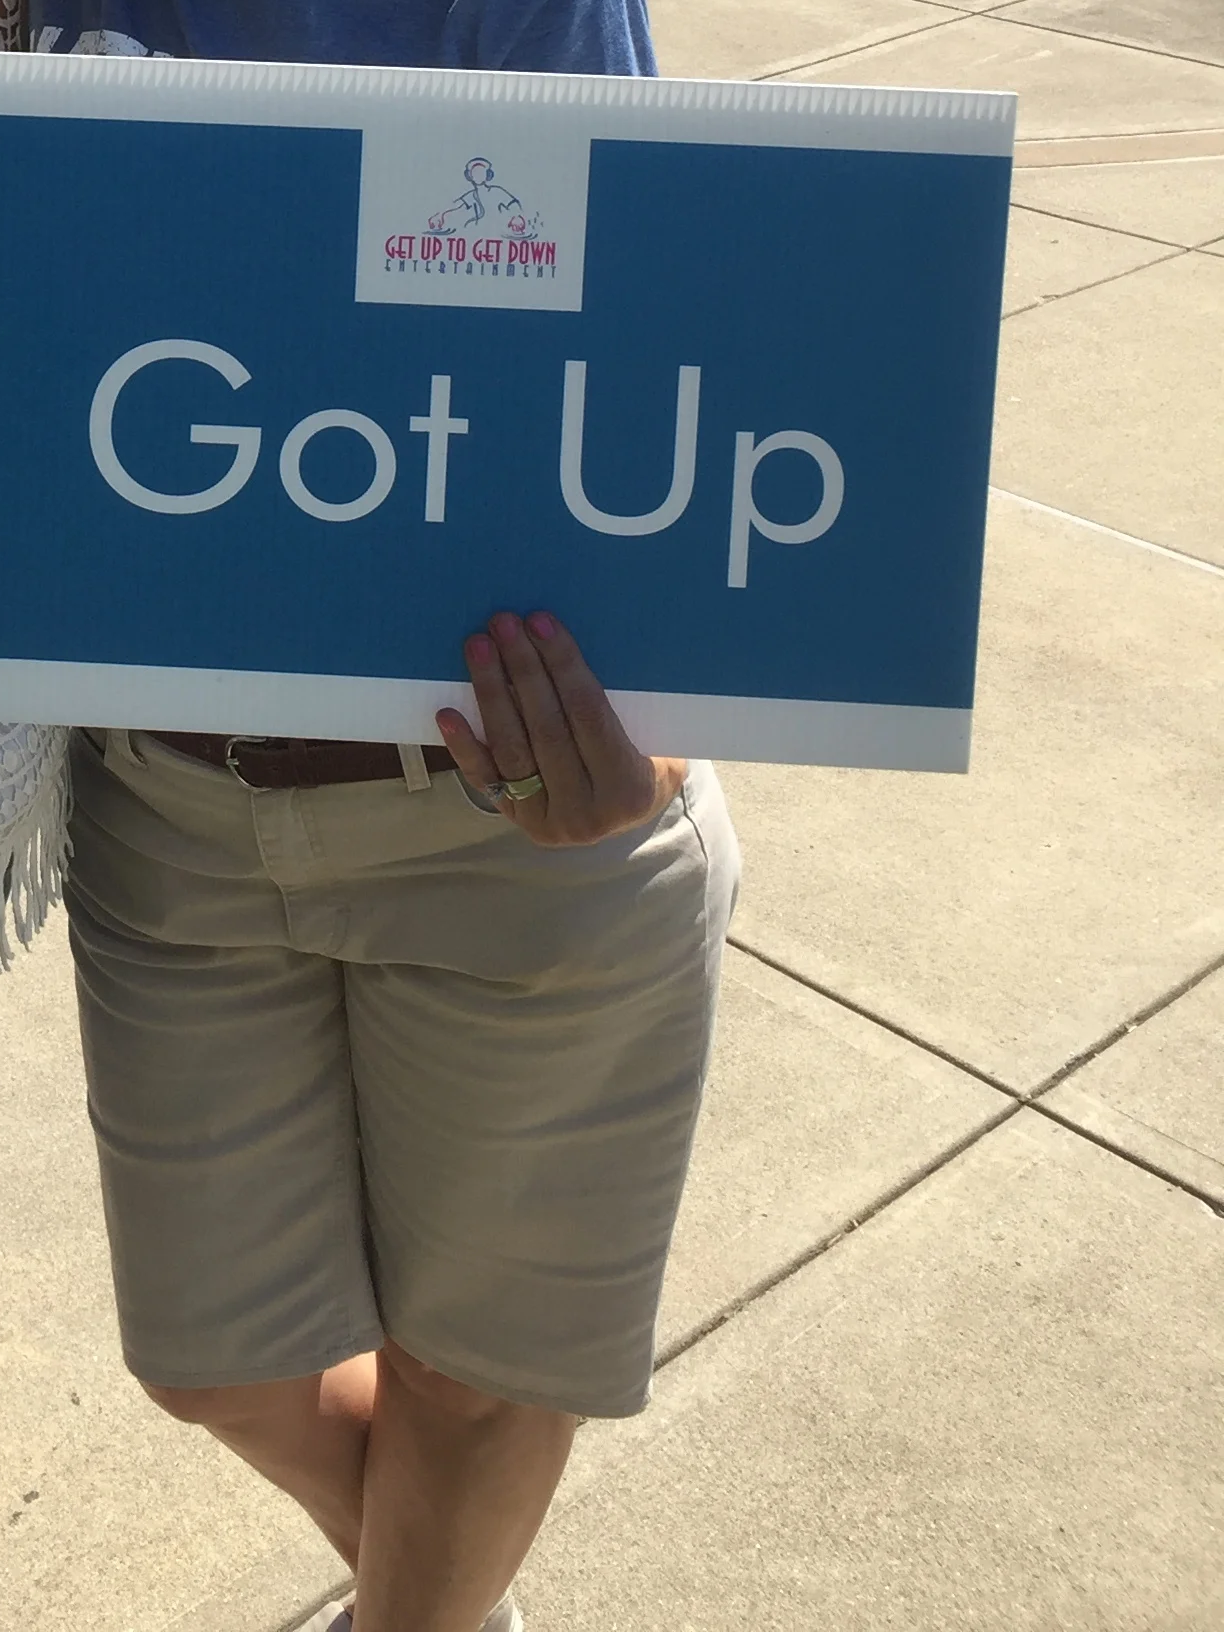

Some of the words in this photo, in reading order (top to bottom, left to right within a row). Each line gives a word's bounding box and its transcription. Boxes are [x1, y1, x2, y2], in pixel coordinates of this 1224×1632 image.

[384, 234, 416, 259] GET
[420, 236, 443, 261] UP
[446, 237, 467, 262] TO
[472, 239, 503, 263] GET
[507, 240, 557, 265] DOWN
[383, 258, 557, 279] ENTERTAINMENT
[89, 339, 468, 523] Got
[560, 360, 844, 589] Up
